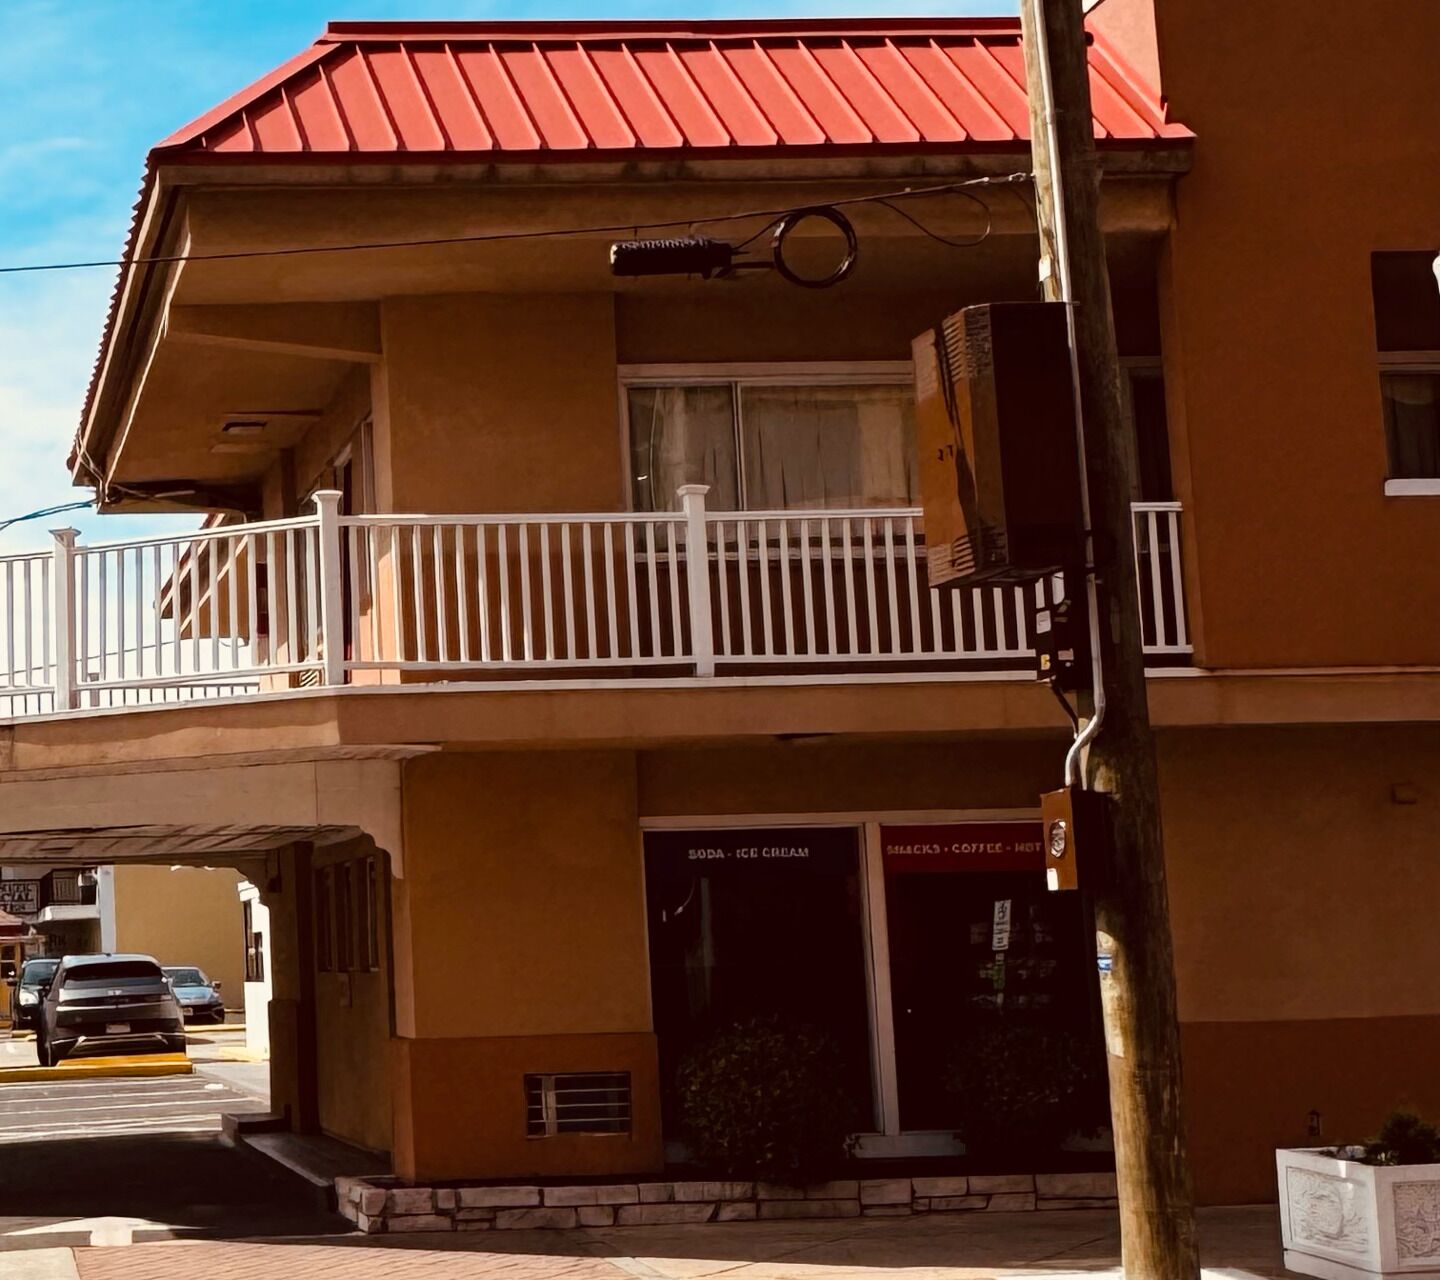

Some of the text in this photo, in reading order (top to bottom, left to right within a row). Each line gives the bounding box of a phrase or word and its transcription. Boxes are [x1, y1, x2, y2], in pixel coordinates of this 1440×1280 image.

[688, 848, 726, 860] SODA
[736, 847, 758, 859] ICE
[762, 846, 810, 858] CREAM
[886, 843, 941, 855] SNACKS
[952, 842, 1003, 854] COFFEE
[1015, 841, 1042, 854] HOT
